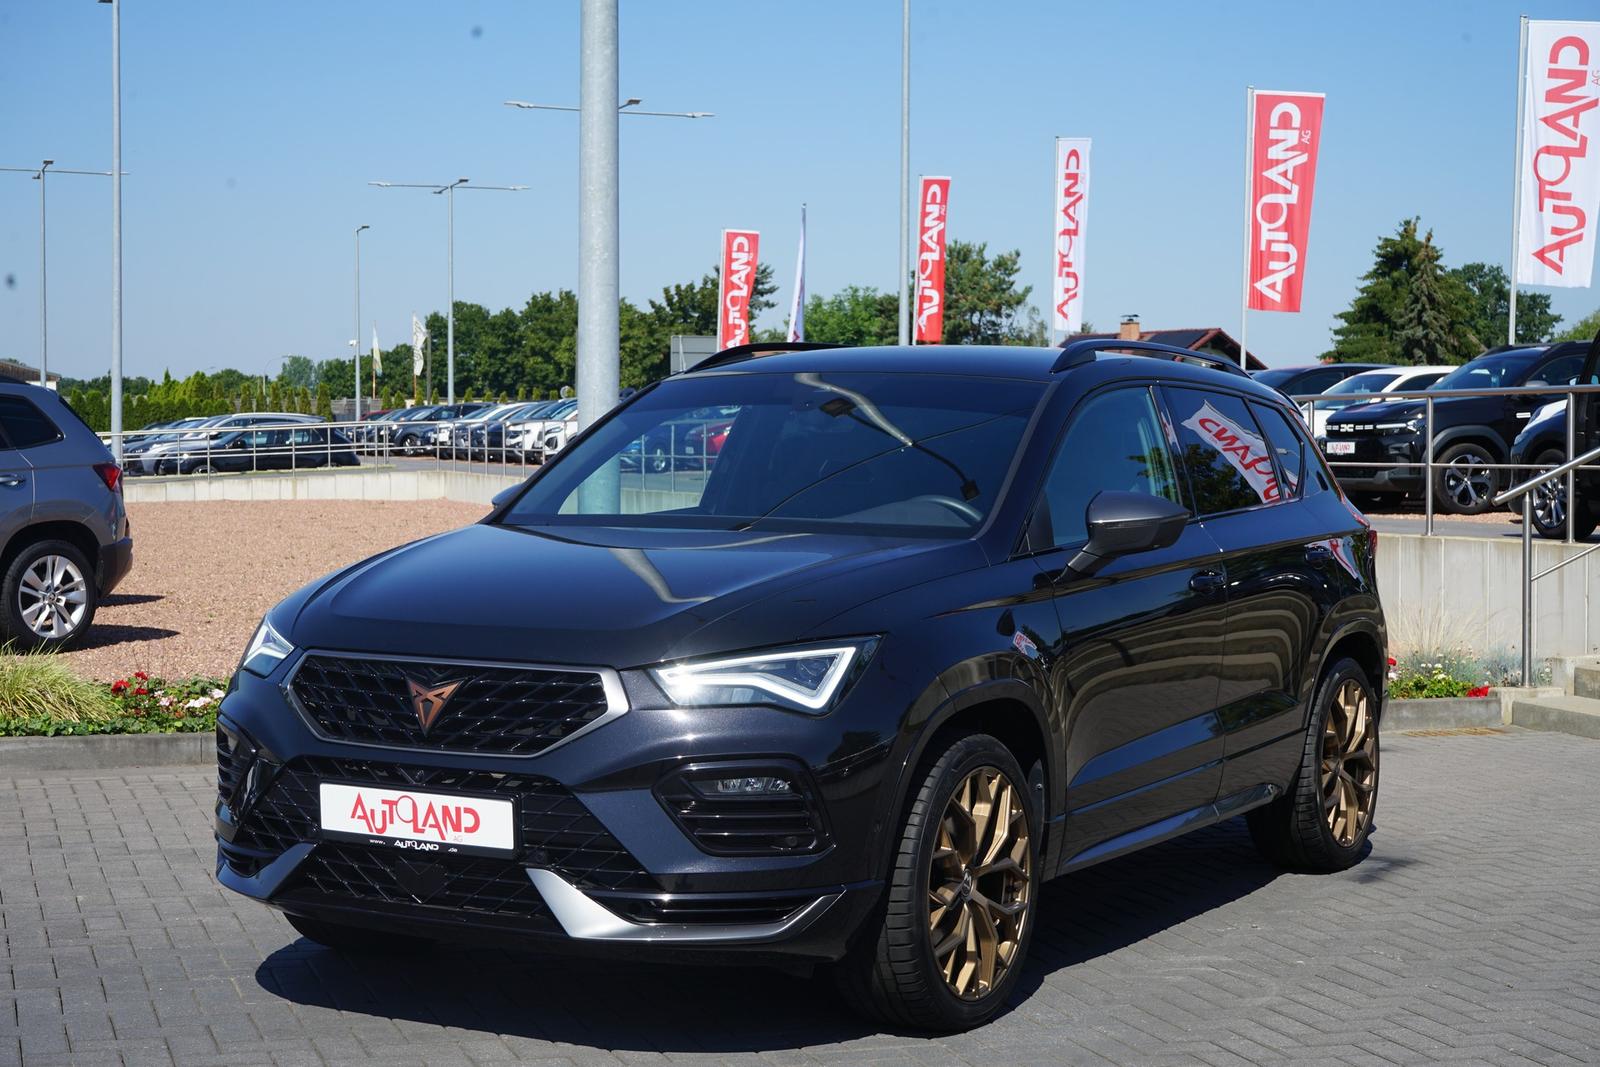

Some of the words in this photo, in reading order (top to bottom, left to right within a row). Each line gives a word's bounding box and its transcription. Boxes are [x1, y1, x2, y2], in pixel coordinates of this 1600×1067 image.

[1253, 102, 1309, 303] AUTOLAND
[1301, 129, 1312, 145] AG
[1532, 36, 1600, 275] AUTOLAND
[918, 184, 945, 334] AUTOLAND
[1057, 149, 1084, 320] AUTOLAND
[351, 792, 480, 841] AUTOLAND
[394, 839, 440, 851] AUTOLAND
